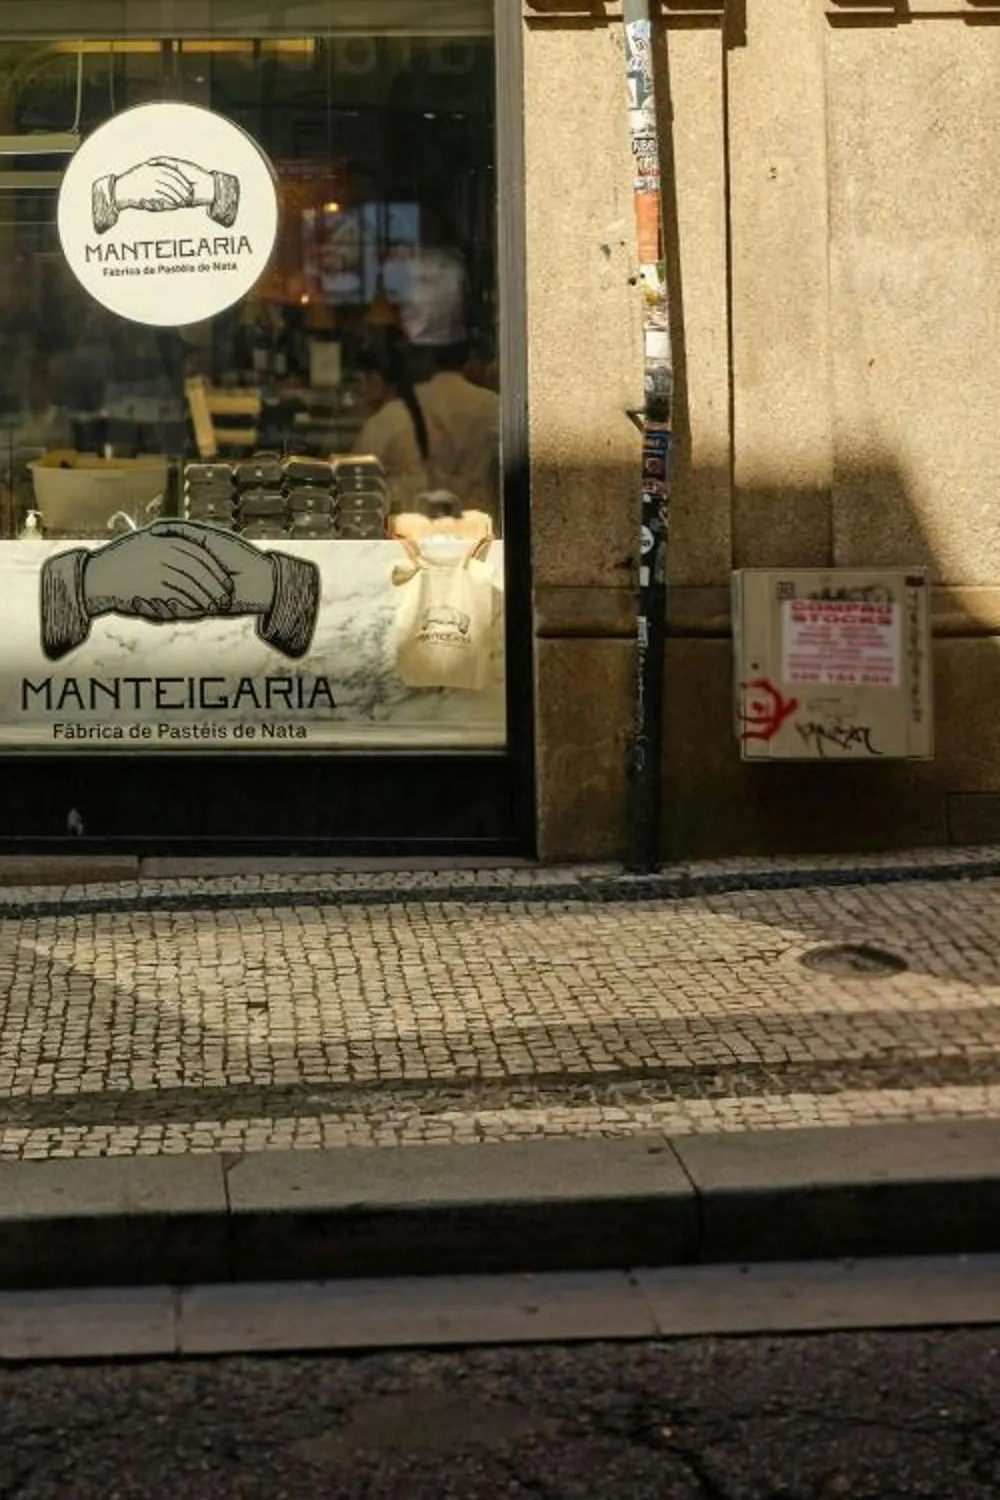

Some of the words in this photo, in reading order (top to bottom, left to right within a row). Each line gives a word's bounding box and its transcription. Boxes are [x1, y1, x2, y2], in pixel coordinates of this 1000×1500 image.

[86, 235, 253, 262] MANTEIGARIA
[143, 265, 156, 275] de
[198, 264, 211, 273] de
[213, 261, 238, 271] Nata
[21, 677, 338, 710] MANTEIGARIA
[129, 723, 152, 739] de
[158, 722, 228, 739] Pastéis
[233, 723, 256, 739] de
[261, 723, 308, 739] Nata
